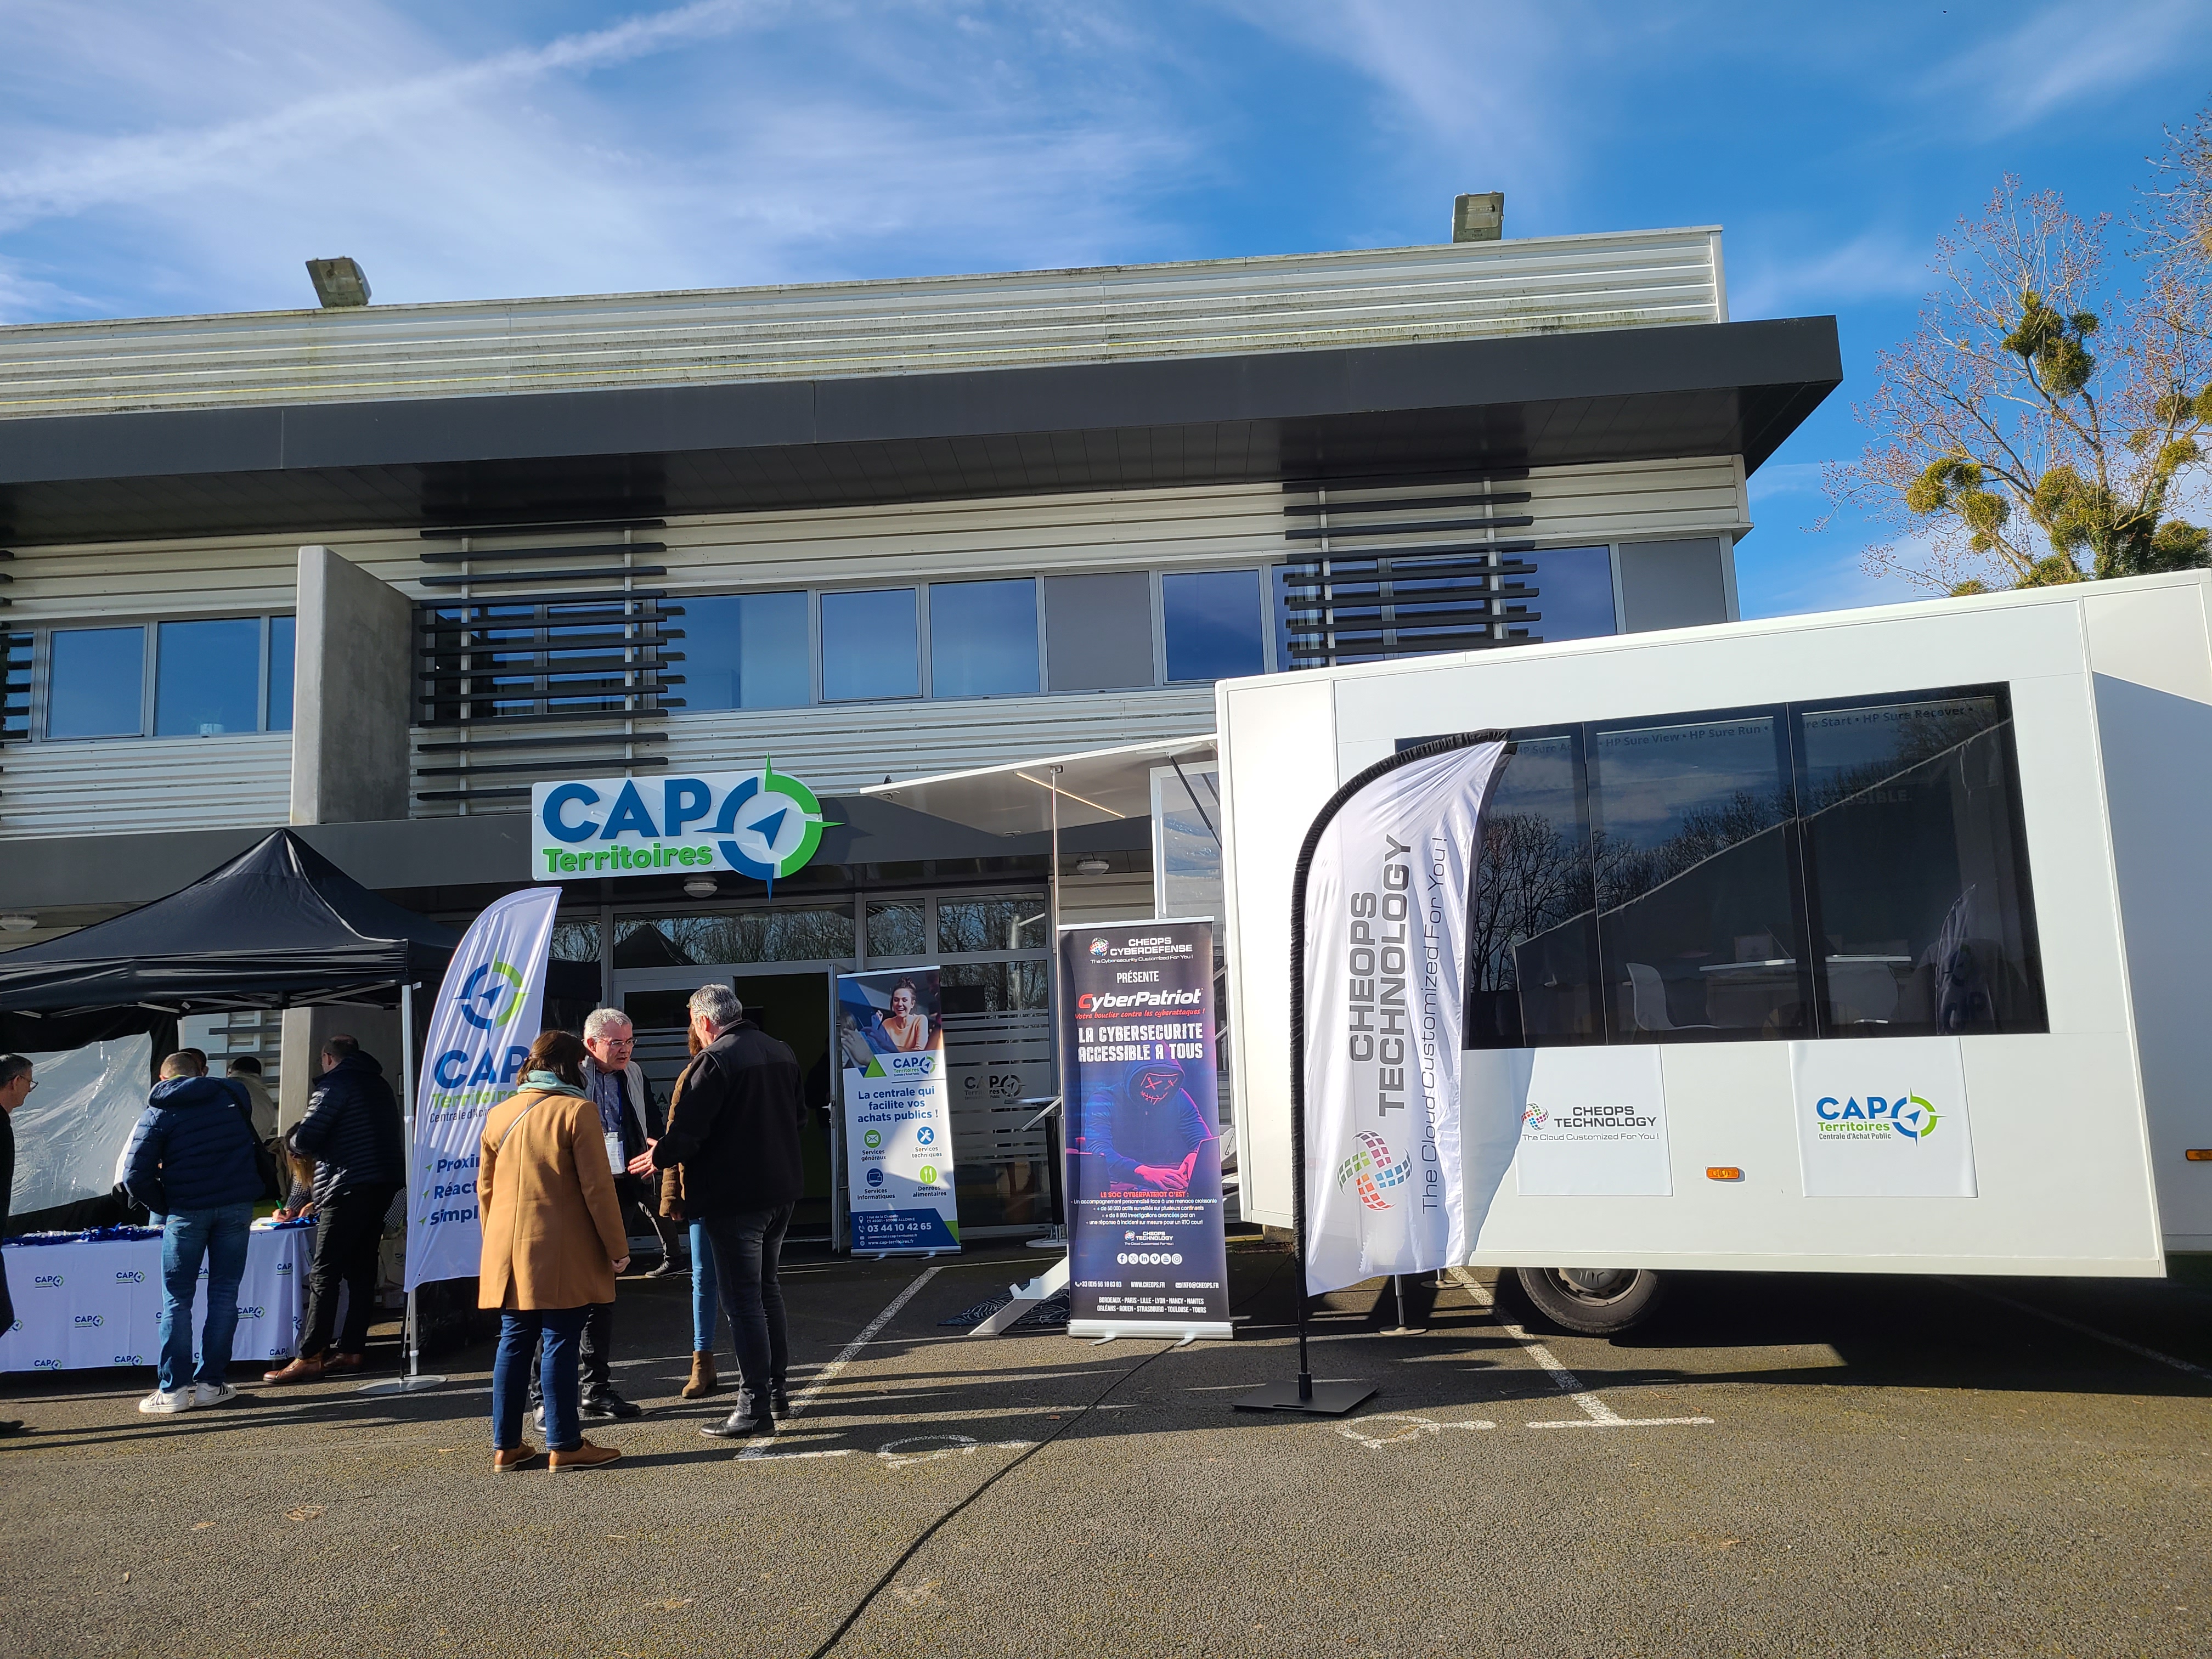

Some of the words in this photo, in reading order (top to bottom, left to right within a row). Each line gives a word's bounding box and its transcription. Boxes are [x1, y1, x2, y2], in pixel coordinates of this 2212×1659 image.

[1821, 716, 1851, 727] Start
[1864, 713, 1879, 724] HP
[1883, 712, 1911, 722] Sure
[1915, 708, 1965, 719] Recover
[1606, 738, 1621, 747] HP
[1624, 737, 1649, 746] Sure
[1652, 733, 1680, 743] View
[1690, 730, 1705, 740] HP
[1709, 729, 1735, 738] Sure
[1738, 726, 1760, 736] Run
[543, 778, 711, 843] CAP
[543, 843, 713, 872] Territoires
[1427, 848, 1446, 891] You
[1424, 896, 1442, 940] For
[1110, 944, 1193, 956] CYBERDEFENSE
[1128, 936, 1172, 947] CHEOPS
[1117, 970, 1159, 984] PRÉSENTE
[1348, 892, 1377, 1062] CHEOPS
[1378, 834, 1412, 1118] TECHNOLOGY
[1078, 989, 1201, 1012] CyberPatriot
[1154, 1008, 1200, 1018] cyberattaques
[1421, 946, 1440, 1090] Customized
[1079, 1027, 1094, 1043] LA
[1099, 1023, 1203, 1042] CYBERSECURITE
[1078, 1044, 1150, 1062] ACCESSIBLE
[1155, 1043, 1164, 1060] A
[1169, 1042, 1203, 1059] TOUS
[435, 1045, 531, 1089] CAP
[893, 1057, 918, 1068] CAP
[858, 1091, 870, 1099] La
[873, 1087, 916, 1098] centrale
[918, 1086, 935, 1097] qui
[868, 1099, 904, 1110] facilite
[1572, 1106, 1634, 1116] CHEOPS
[1816, 1096, 1887, 1120] CAP
[430, 1110, 466, 1123] Centrale
[857, 1112, 891, 1122] achats
[894, 1110, 932, 1122] publics
[1554, 1116, 1657, 1127] TECHNOLOGY
[1421, 1094, 1438, 1163] Cloud
[1818, 1121, 1890, 1132] Territoires
[437, 1154, 479, 1173] Proxi
[1421, 1169, 1438, 1214] The
[430, 1205, 478, 1226] Simpl
